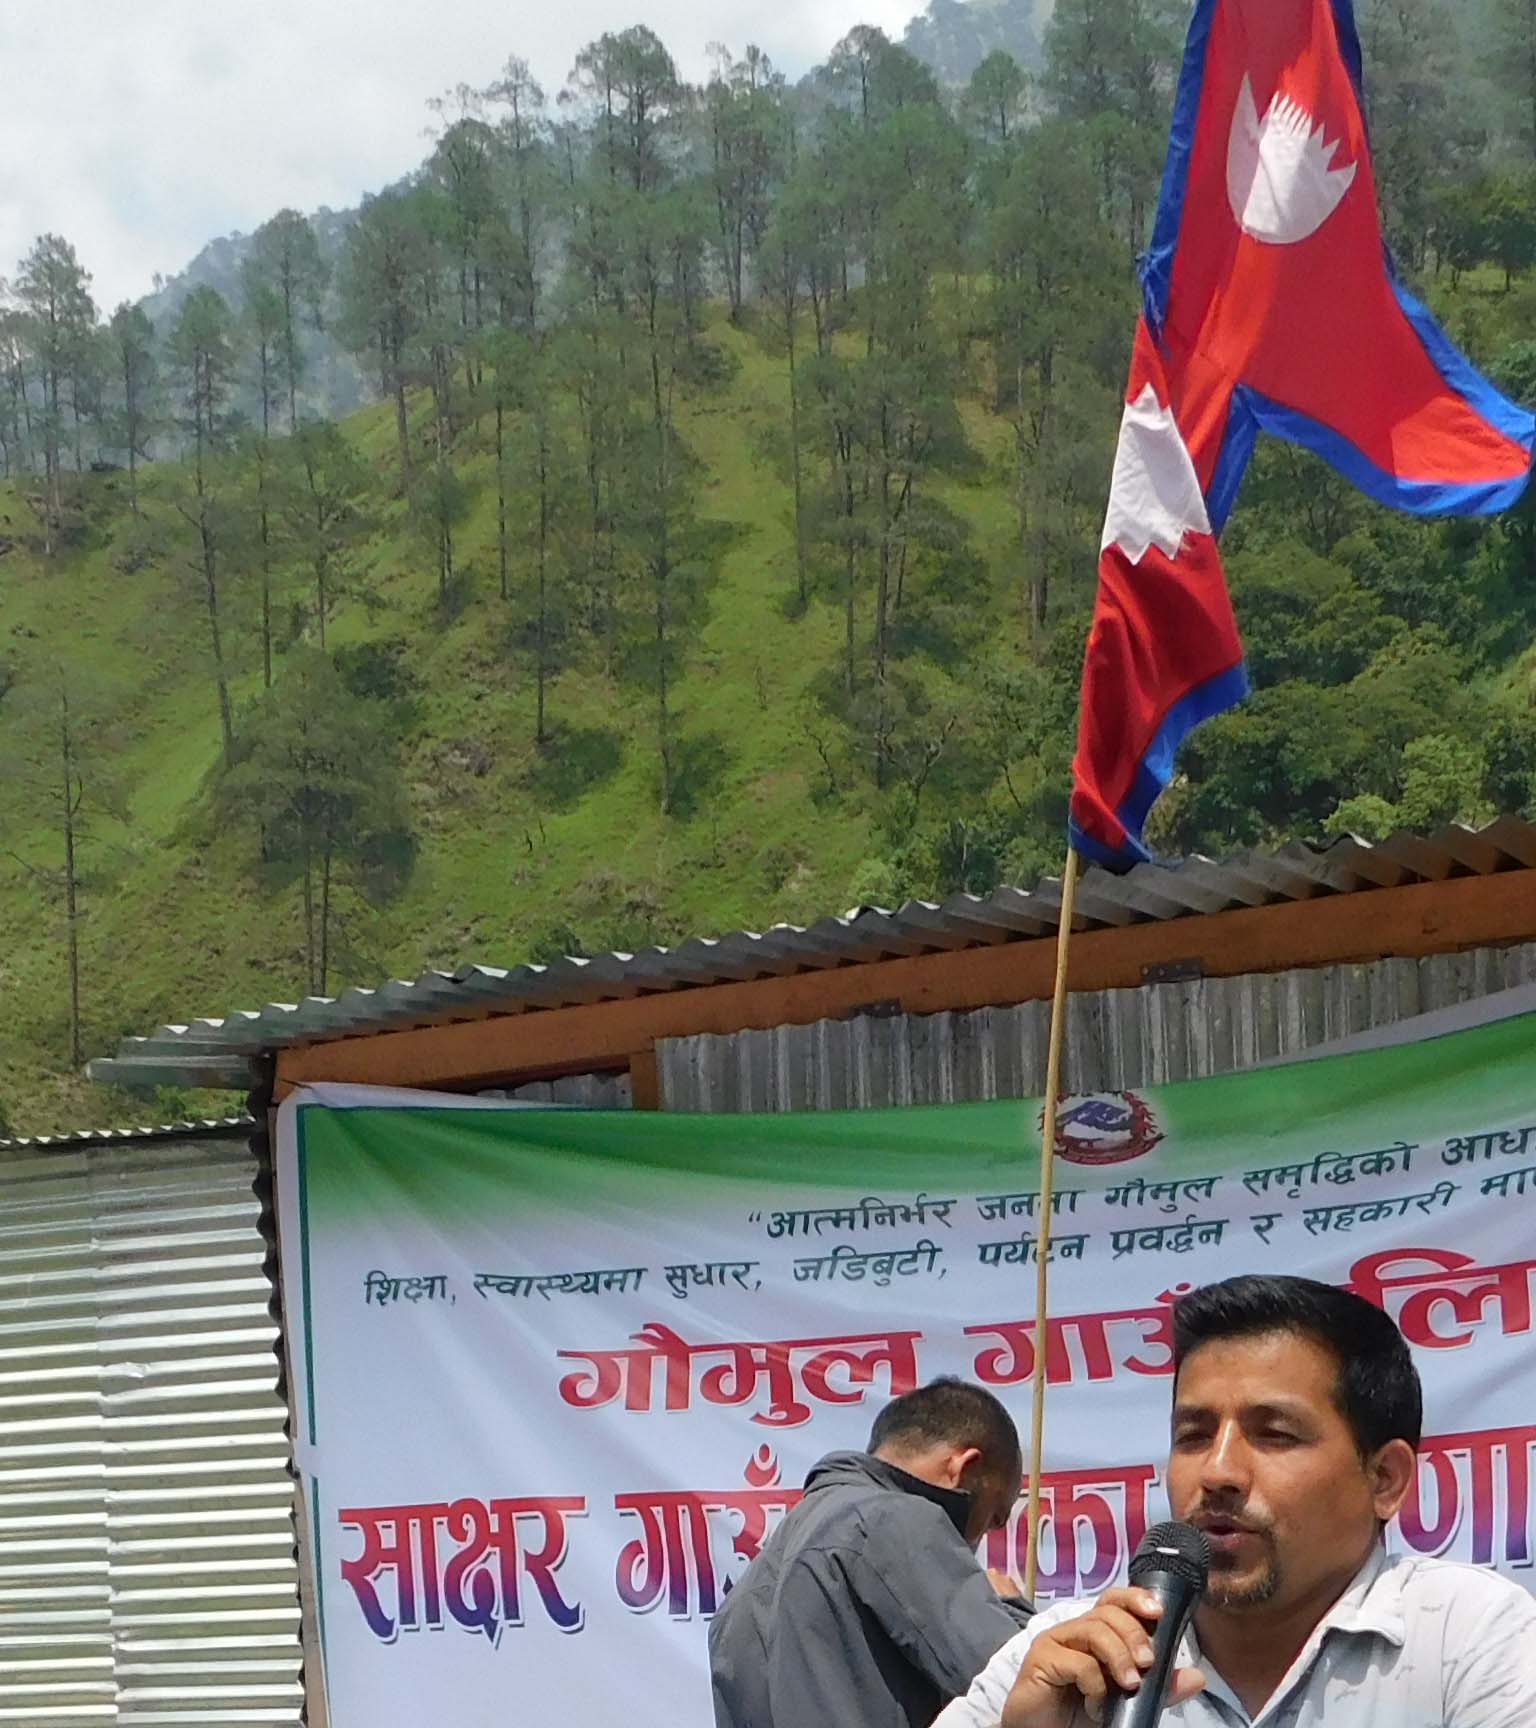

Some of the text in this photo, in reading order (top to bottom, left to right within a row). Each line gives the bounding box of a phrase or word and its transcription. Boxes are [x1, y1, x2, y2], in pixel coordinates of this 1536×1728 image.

[1104, 1176, 1222, 1212] गौमुल
[1243, 1142, 1419, 1198] समृद्धिको
[364, 1270, 456, 1305] शिक्षा,
[664, 1261, 761, 1299] सुधार,
[1250, 1213, 1282, 1245] र
[1303, 1183, 1462, 1236] सहकारी
[557, 1322, 923, 1427] गौमुल
[337, 1497, 587, 1645] साक्षर
